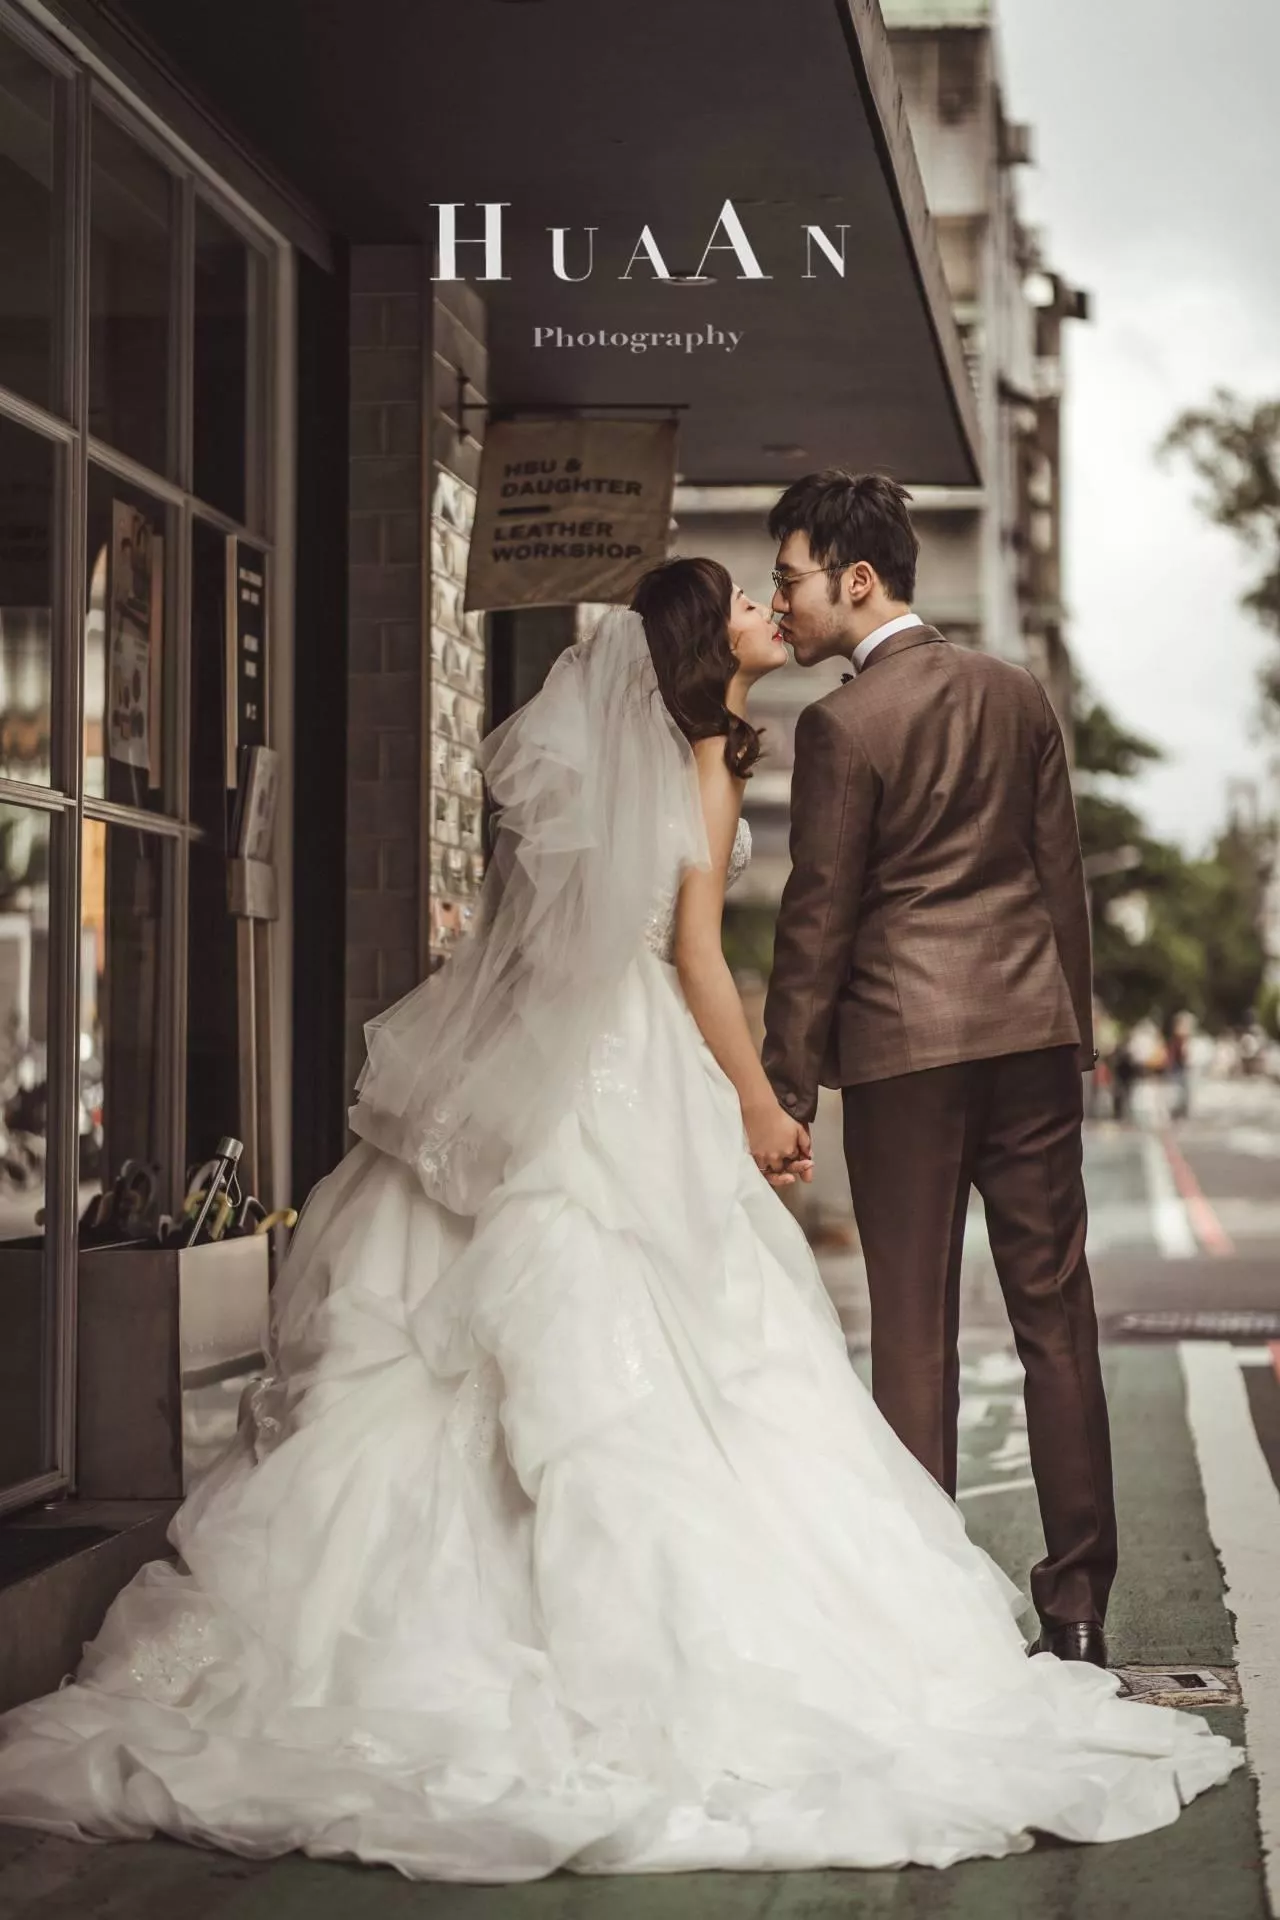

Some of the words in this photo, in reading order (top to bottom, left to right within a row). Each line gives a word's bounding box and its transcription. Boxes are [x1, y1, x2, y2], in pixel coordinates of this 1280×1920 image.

[504, 459, 557, 477] HSU
[565, 457, 582, 473] &
[502, 477, 643, 498] DAUGHTER
[494, 521, 613, 541] LEATHER
[492, 543, 643, 563] WORKSHOP
